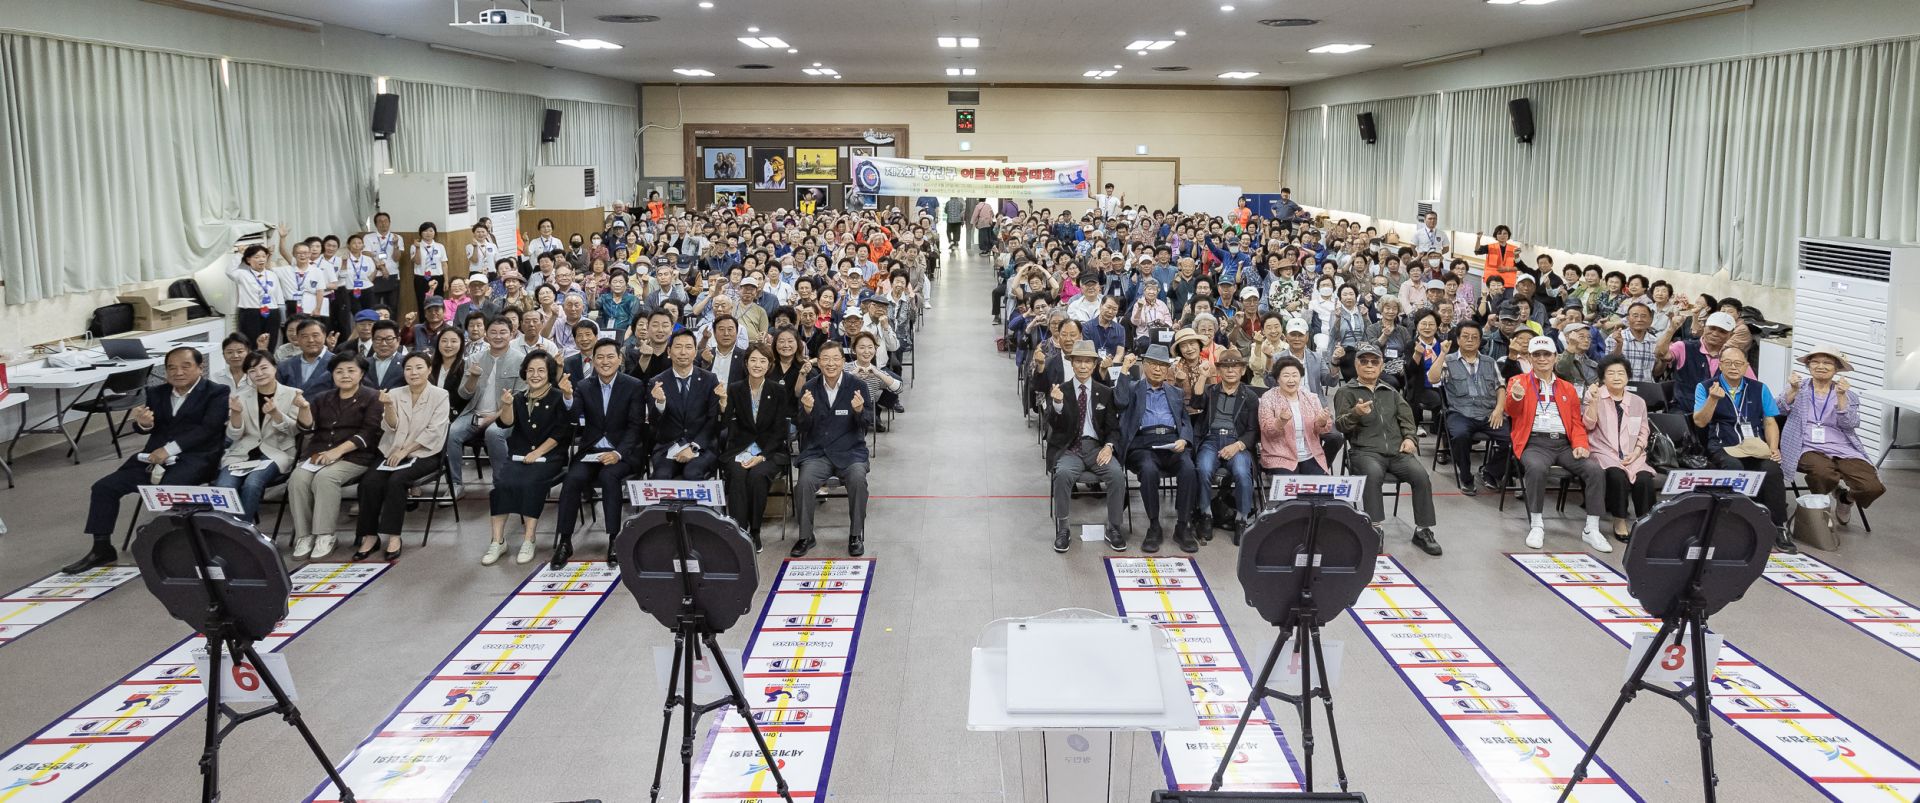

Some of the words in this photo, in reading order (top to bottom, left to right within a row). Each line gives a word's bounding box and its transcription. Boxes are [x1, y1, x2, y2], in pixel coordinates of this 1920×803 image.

[885, 166, 915, 178] 제2회
[918, 165, 958, 181] 광진구
[960, 167, 1000, 182] 어르신
[1003, 167, 1056, 183] 한궁대회
[1661, 643, 1687, 671] 3
[231, 661, 260, 692] 6
